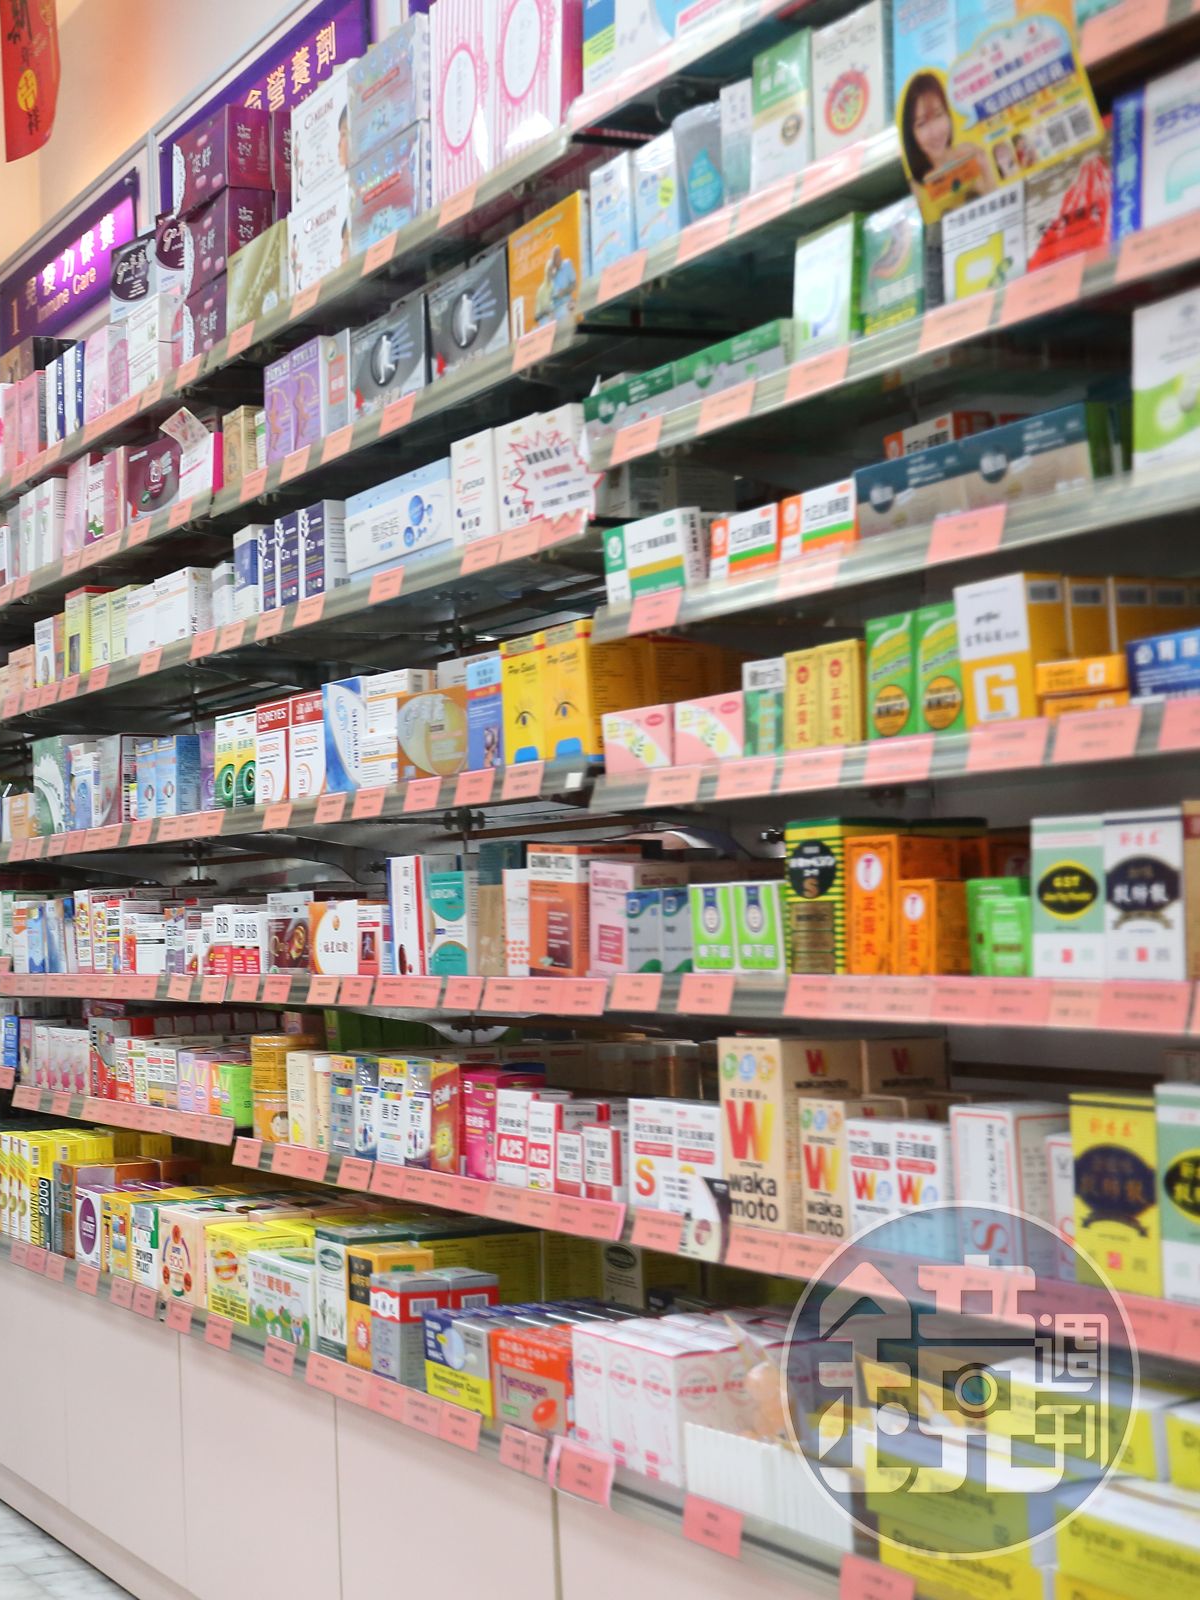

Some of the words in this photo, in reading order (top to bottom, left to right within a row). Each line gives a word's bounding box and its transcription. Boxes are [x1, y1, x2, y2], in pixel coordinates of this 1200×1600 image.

[72, 267, 97, 294] Care
[973, 663, 1020, 723] G
[725, 1099, 775, 1163] W
[498, 1138, 525, 1160] A25
[530, 1147, 550, 1166] A25
[635, 1157, 656, 1197] S
[803, 1143, 840, 1192] W
[39, 1179, 49, 1216] 2000
[729, 1171, 777, 1197] waka
[852, 1170, 876, 1201] W
[897, 1173, 924, 1206] W
[730, 1197, 779, 1223] moto
[806, 1198, 843, 1219] waka
[806, 1217, 845, 1238] moto
